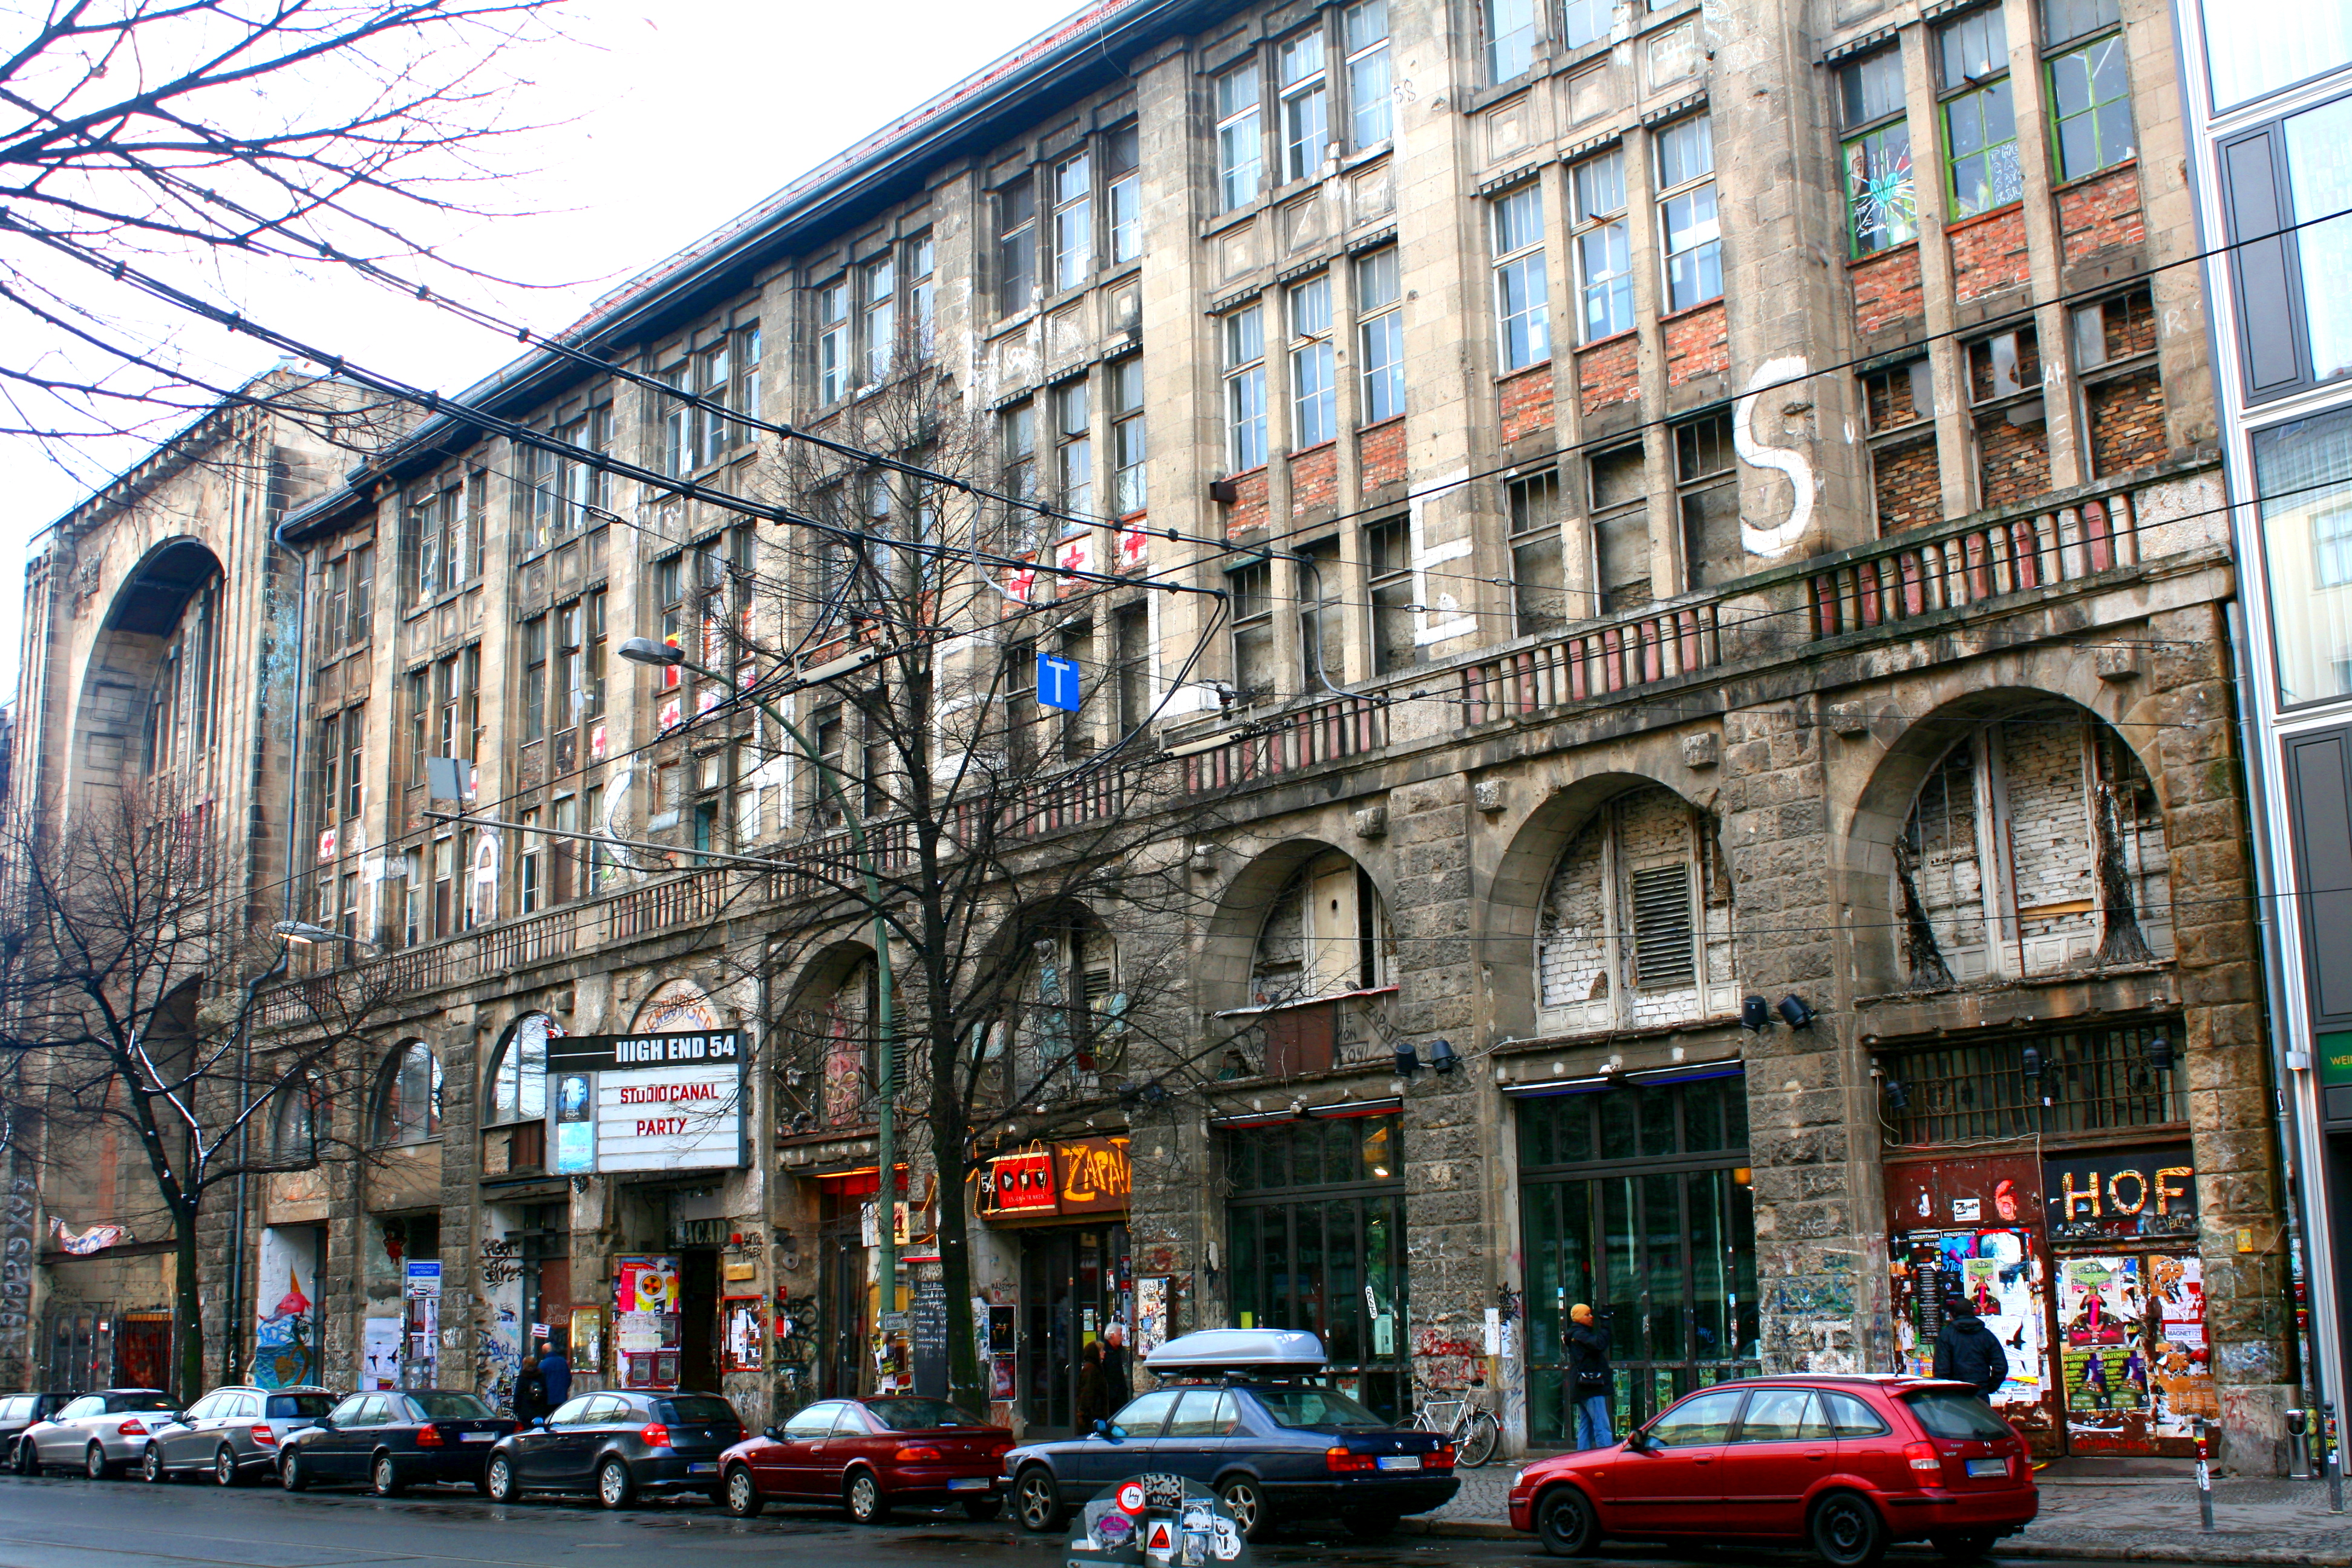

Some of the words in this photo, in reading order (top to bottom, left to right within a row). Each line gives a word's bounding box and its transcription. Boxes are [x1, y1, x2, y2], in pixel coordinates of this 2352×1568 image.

[1734, 356, 1815, 557] S
[1047, 660, 1070, 702] T
[668, 1037, 705, 1060] END
[710, 1035, 736, 1057] 54
[2330, 1055, 2352, 1065] WEI
[670, 1084, 719, 1101] CANAL
[637, 1117, 687, 1136] PARTY
[1062, 1138, 1131, 1201] ZAPAT
[2062, 1166, 2194, 1221] HOF
